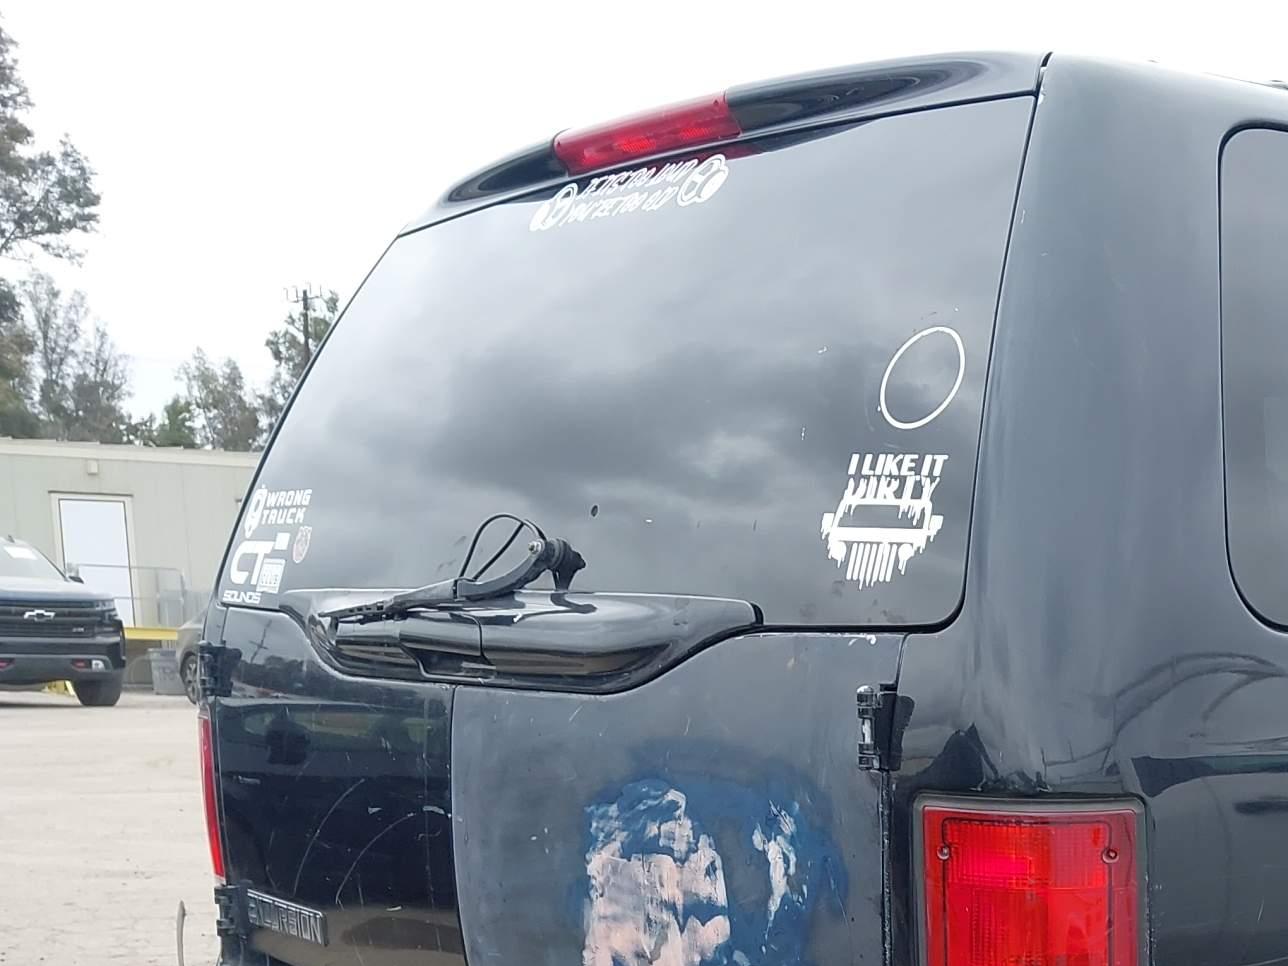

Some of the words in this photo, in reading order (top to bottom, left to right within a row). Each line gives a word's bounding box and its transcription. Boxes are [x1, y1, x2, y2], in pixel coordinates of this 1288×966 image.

[848, 453, 860, 475] I
[861, 453, 919, 476] LIKE
[919, 454, 949, 476] IT
[266, 489, 312, 507] WRONG
[261, 508, 306, 524] TRUCK
[222, 590, 262, 604] SOUNDS
